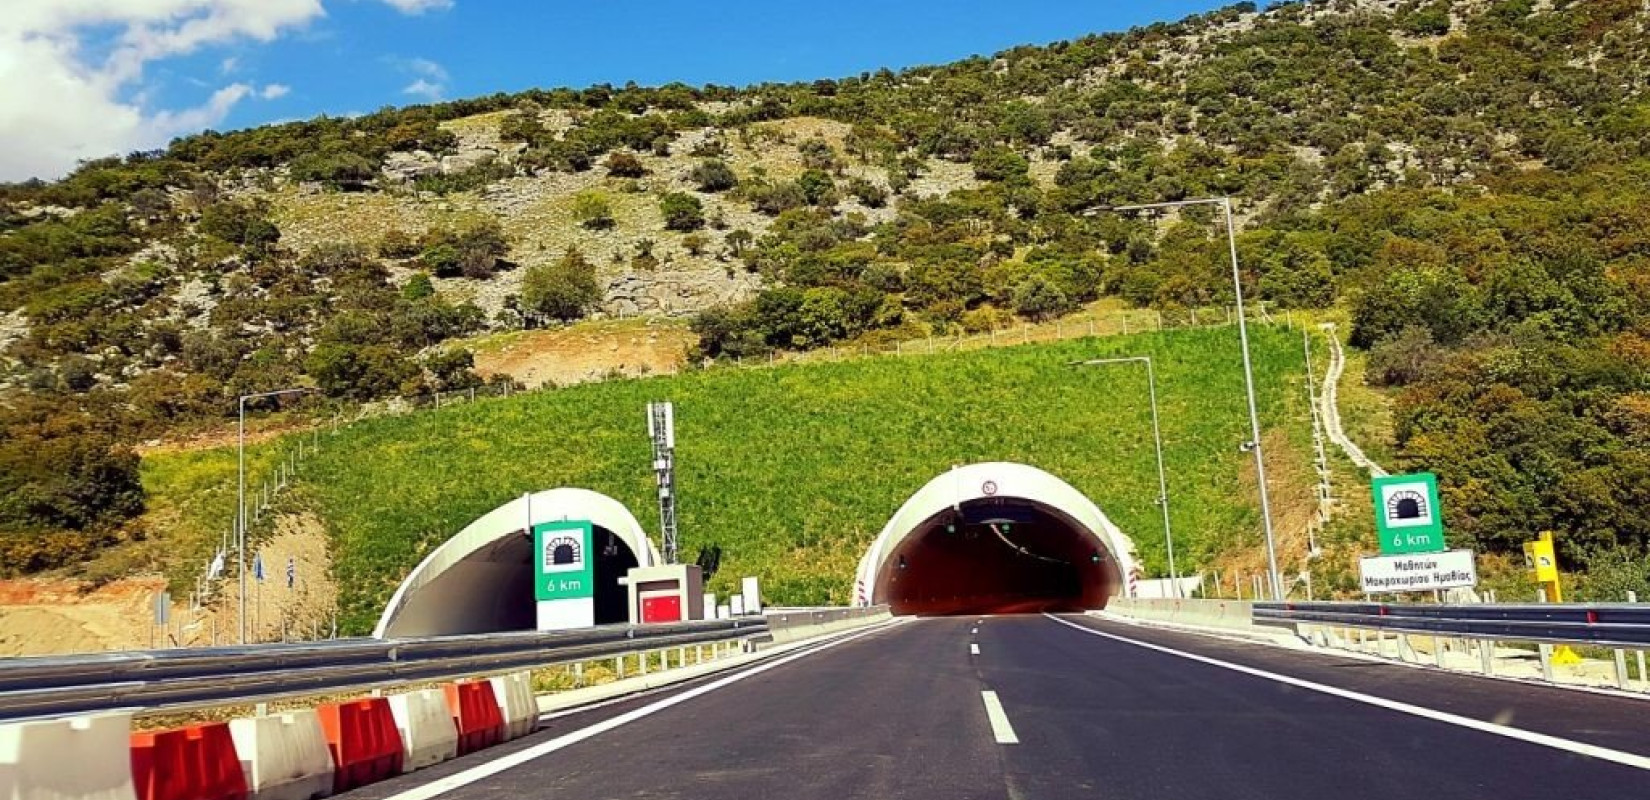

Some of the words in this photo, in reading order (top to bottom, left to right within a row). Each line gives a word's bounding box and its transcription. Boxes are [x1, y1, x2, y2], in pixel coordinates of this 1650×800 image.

[1393, 533, 1403, 547] 6
[1406, 533, 1430, 546] km
[1393, 558, 1438, 571] Μαθητών
[1433, 570, 1472, 584] Ημαθίας
[547, 579, 555, 592] 6
[560, 579, 581, 591] km
